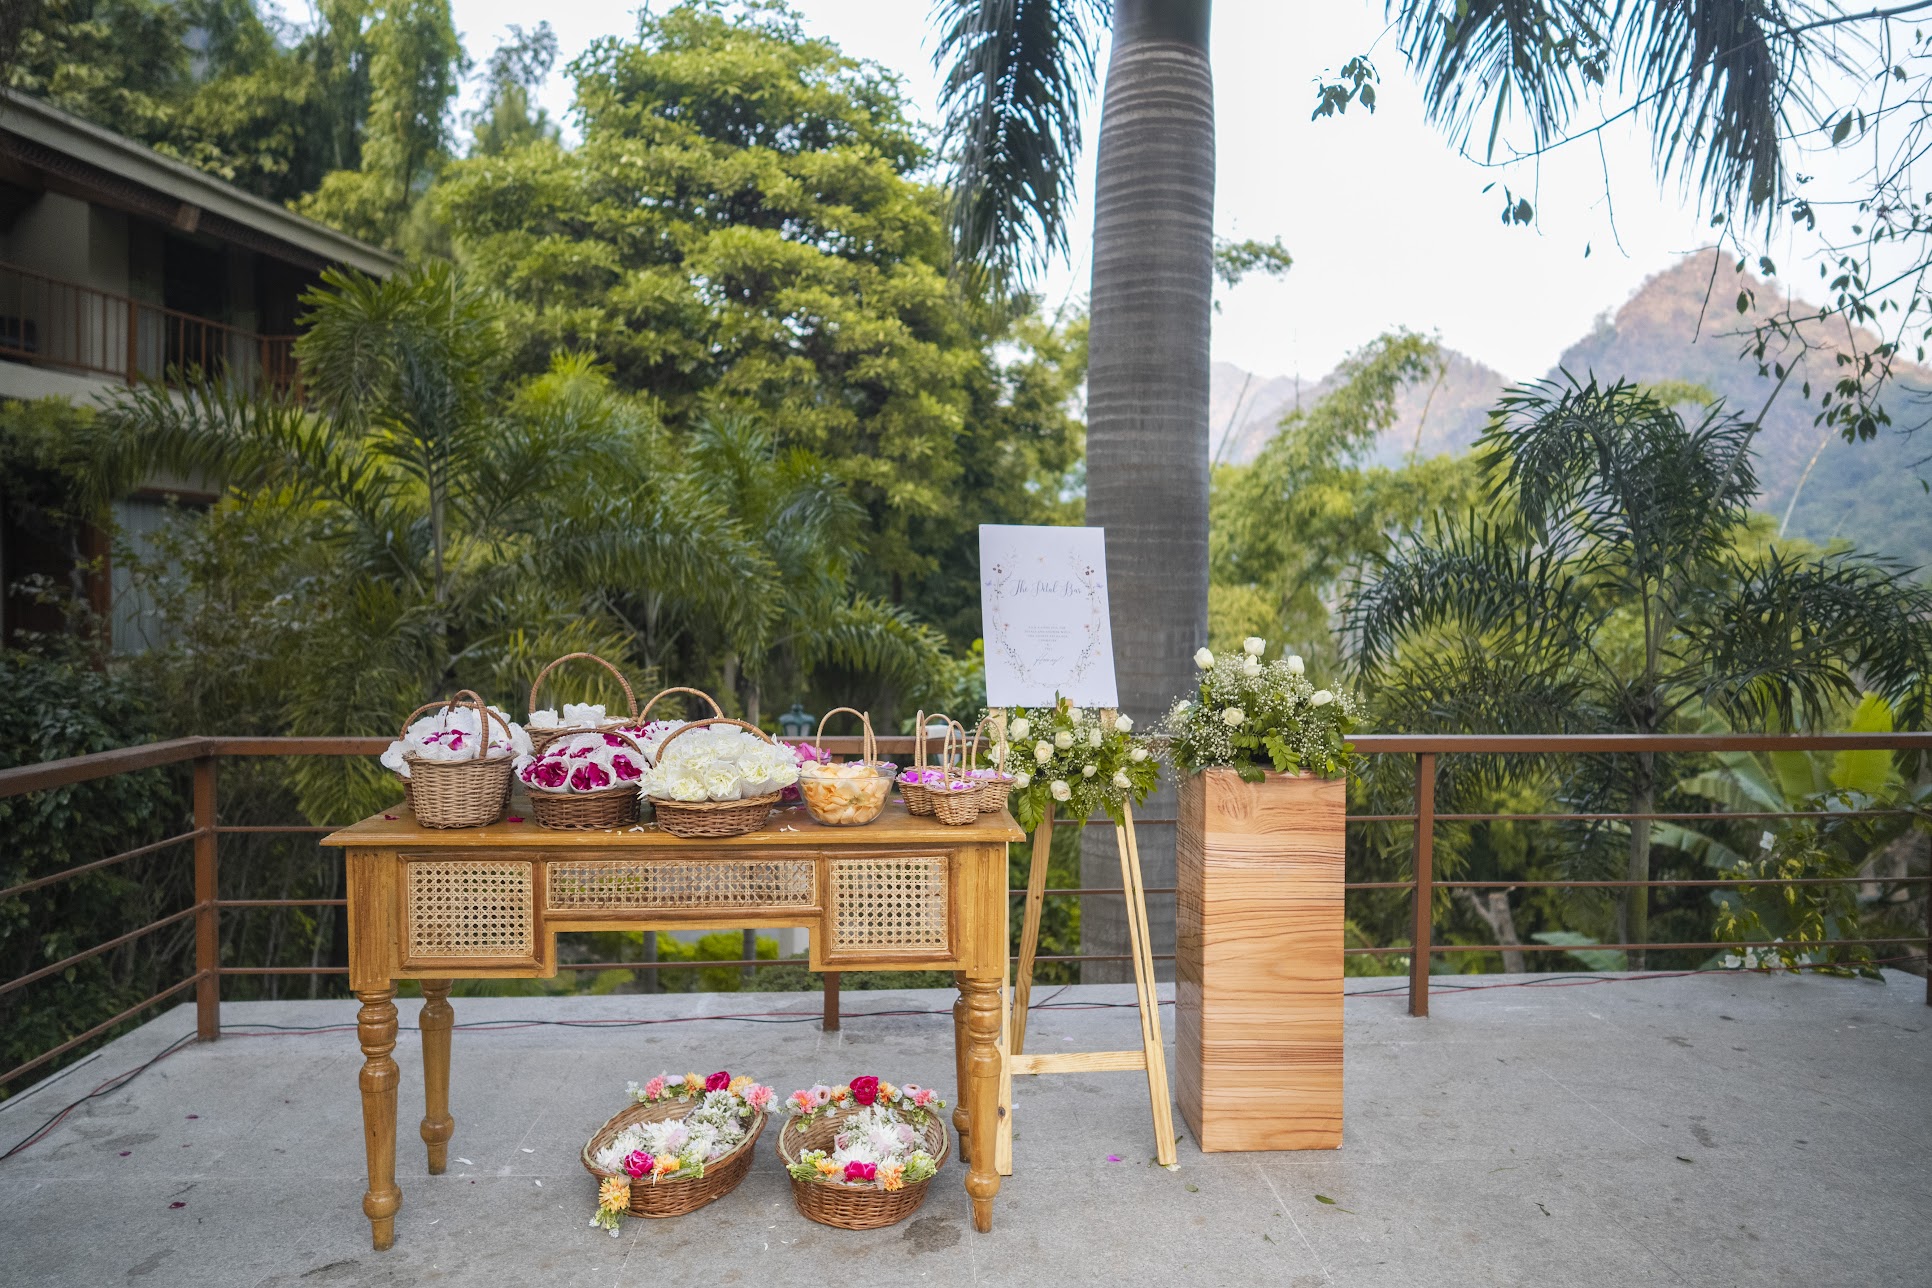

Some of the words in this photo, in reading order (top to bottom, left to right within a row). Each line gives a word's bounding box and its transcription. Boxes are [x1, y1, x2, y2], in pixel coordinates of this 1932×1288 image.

[1011, 579, 1028, 597] The
[1032, 579, 1059, 597] Petal
[1062, 580, 1081, 597] Bar
